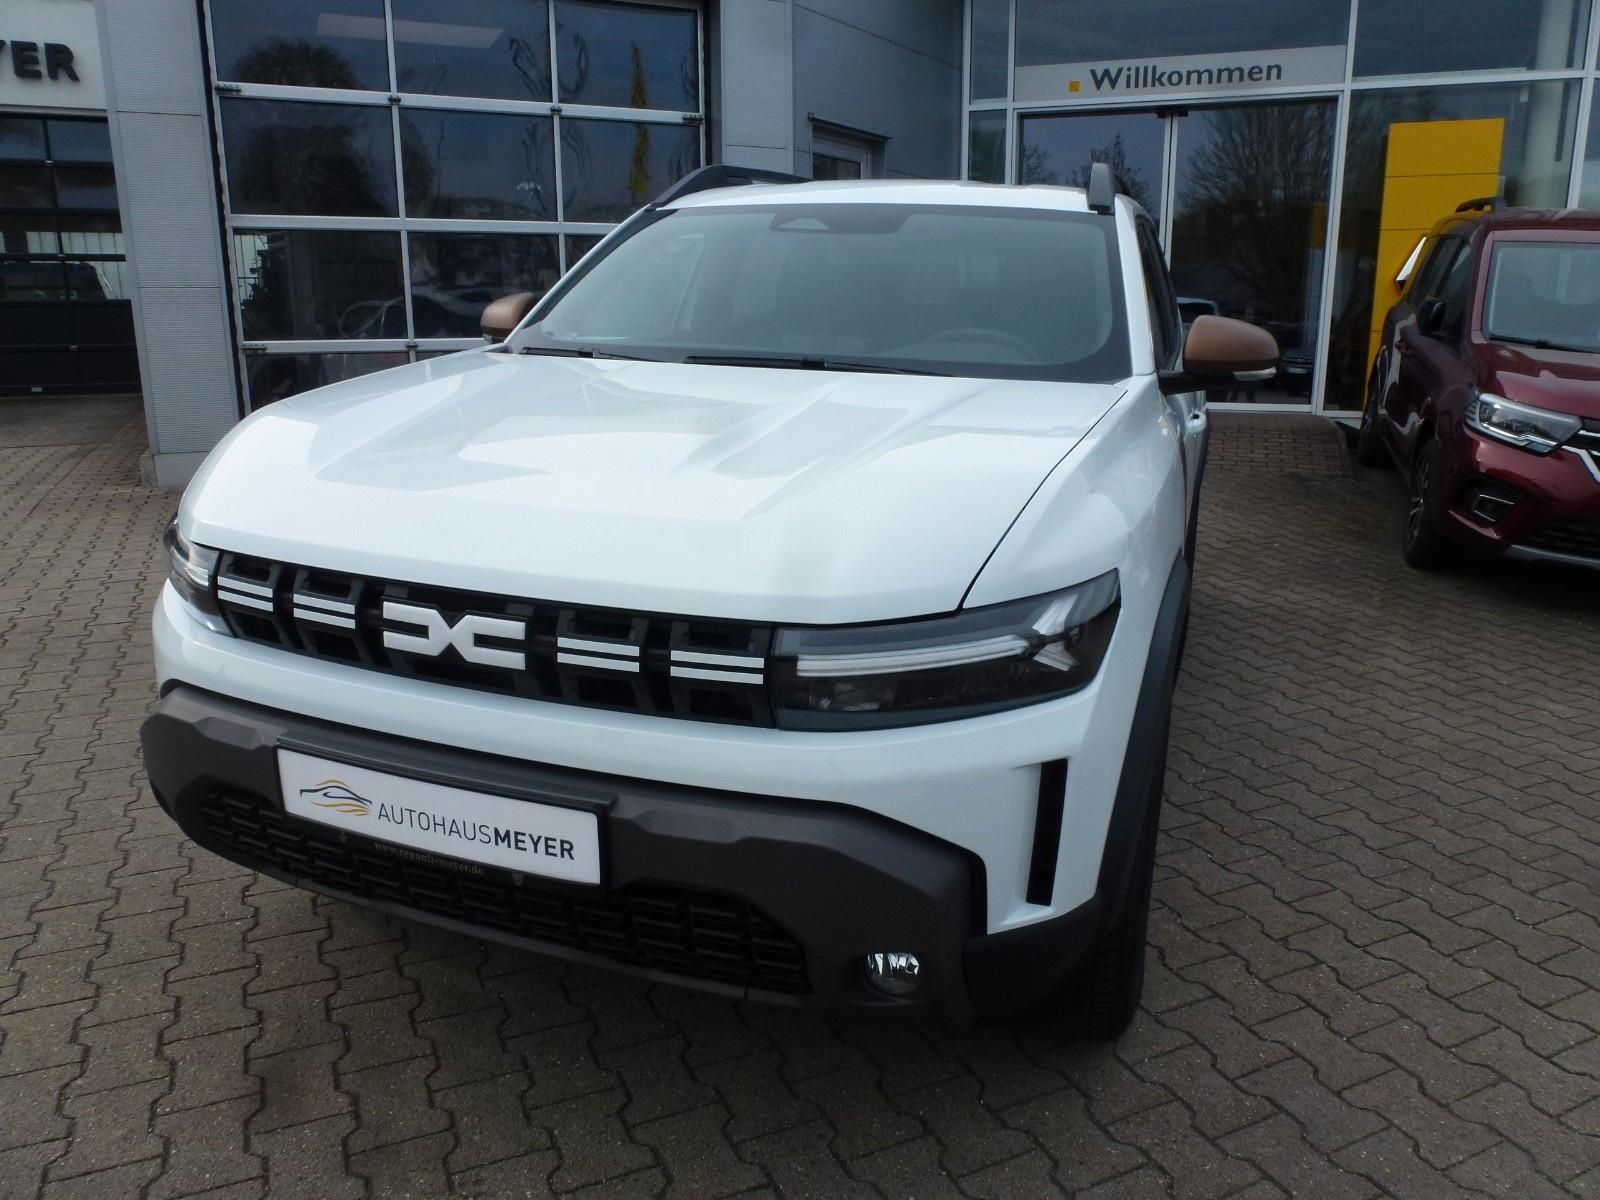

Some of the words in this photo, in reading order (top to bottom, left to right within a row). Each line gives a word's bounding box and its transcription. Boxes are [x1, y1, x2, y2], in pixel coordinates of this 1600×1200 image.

[0, 40, 80, 82] ER
[1090, 64, 1282, 91] Willkommen
[374, 842, 484, 875] www.renault-meyer.de
